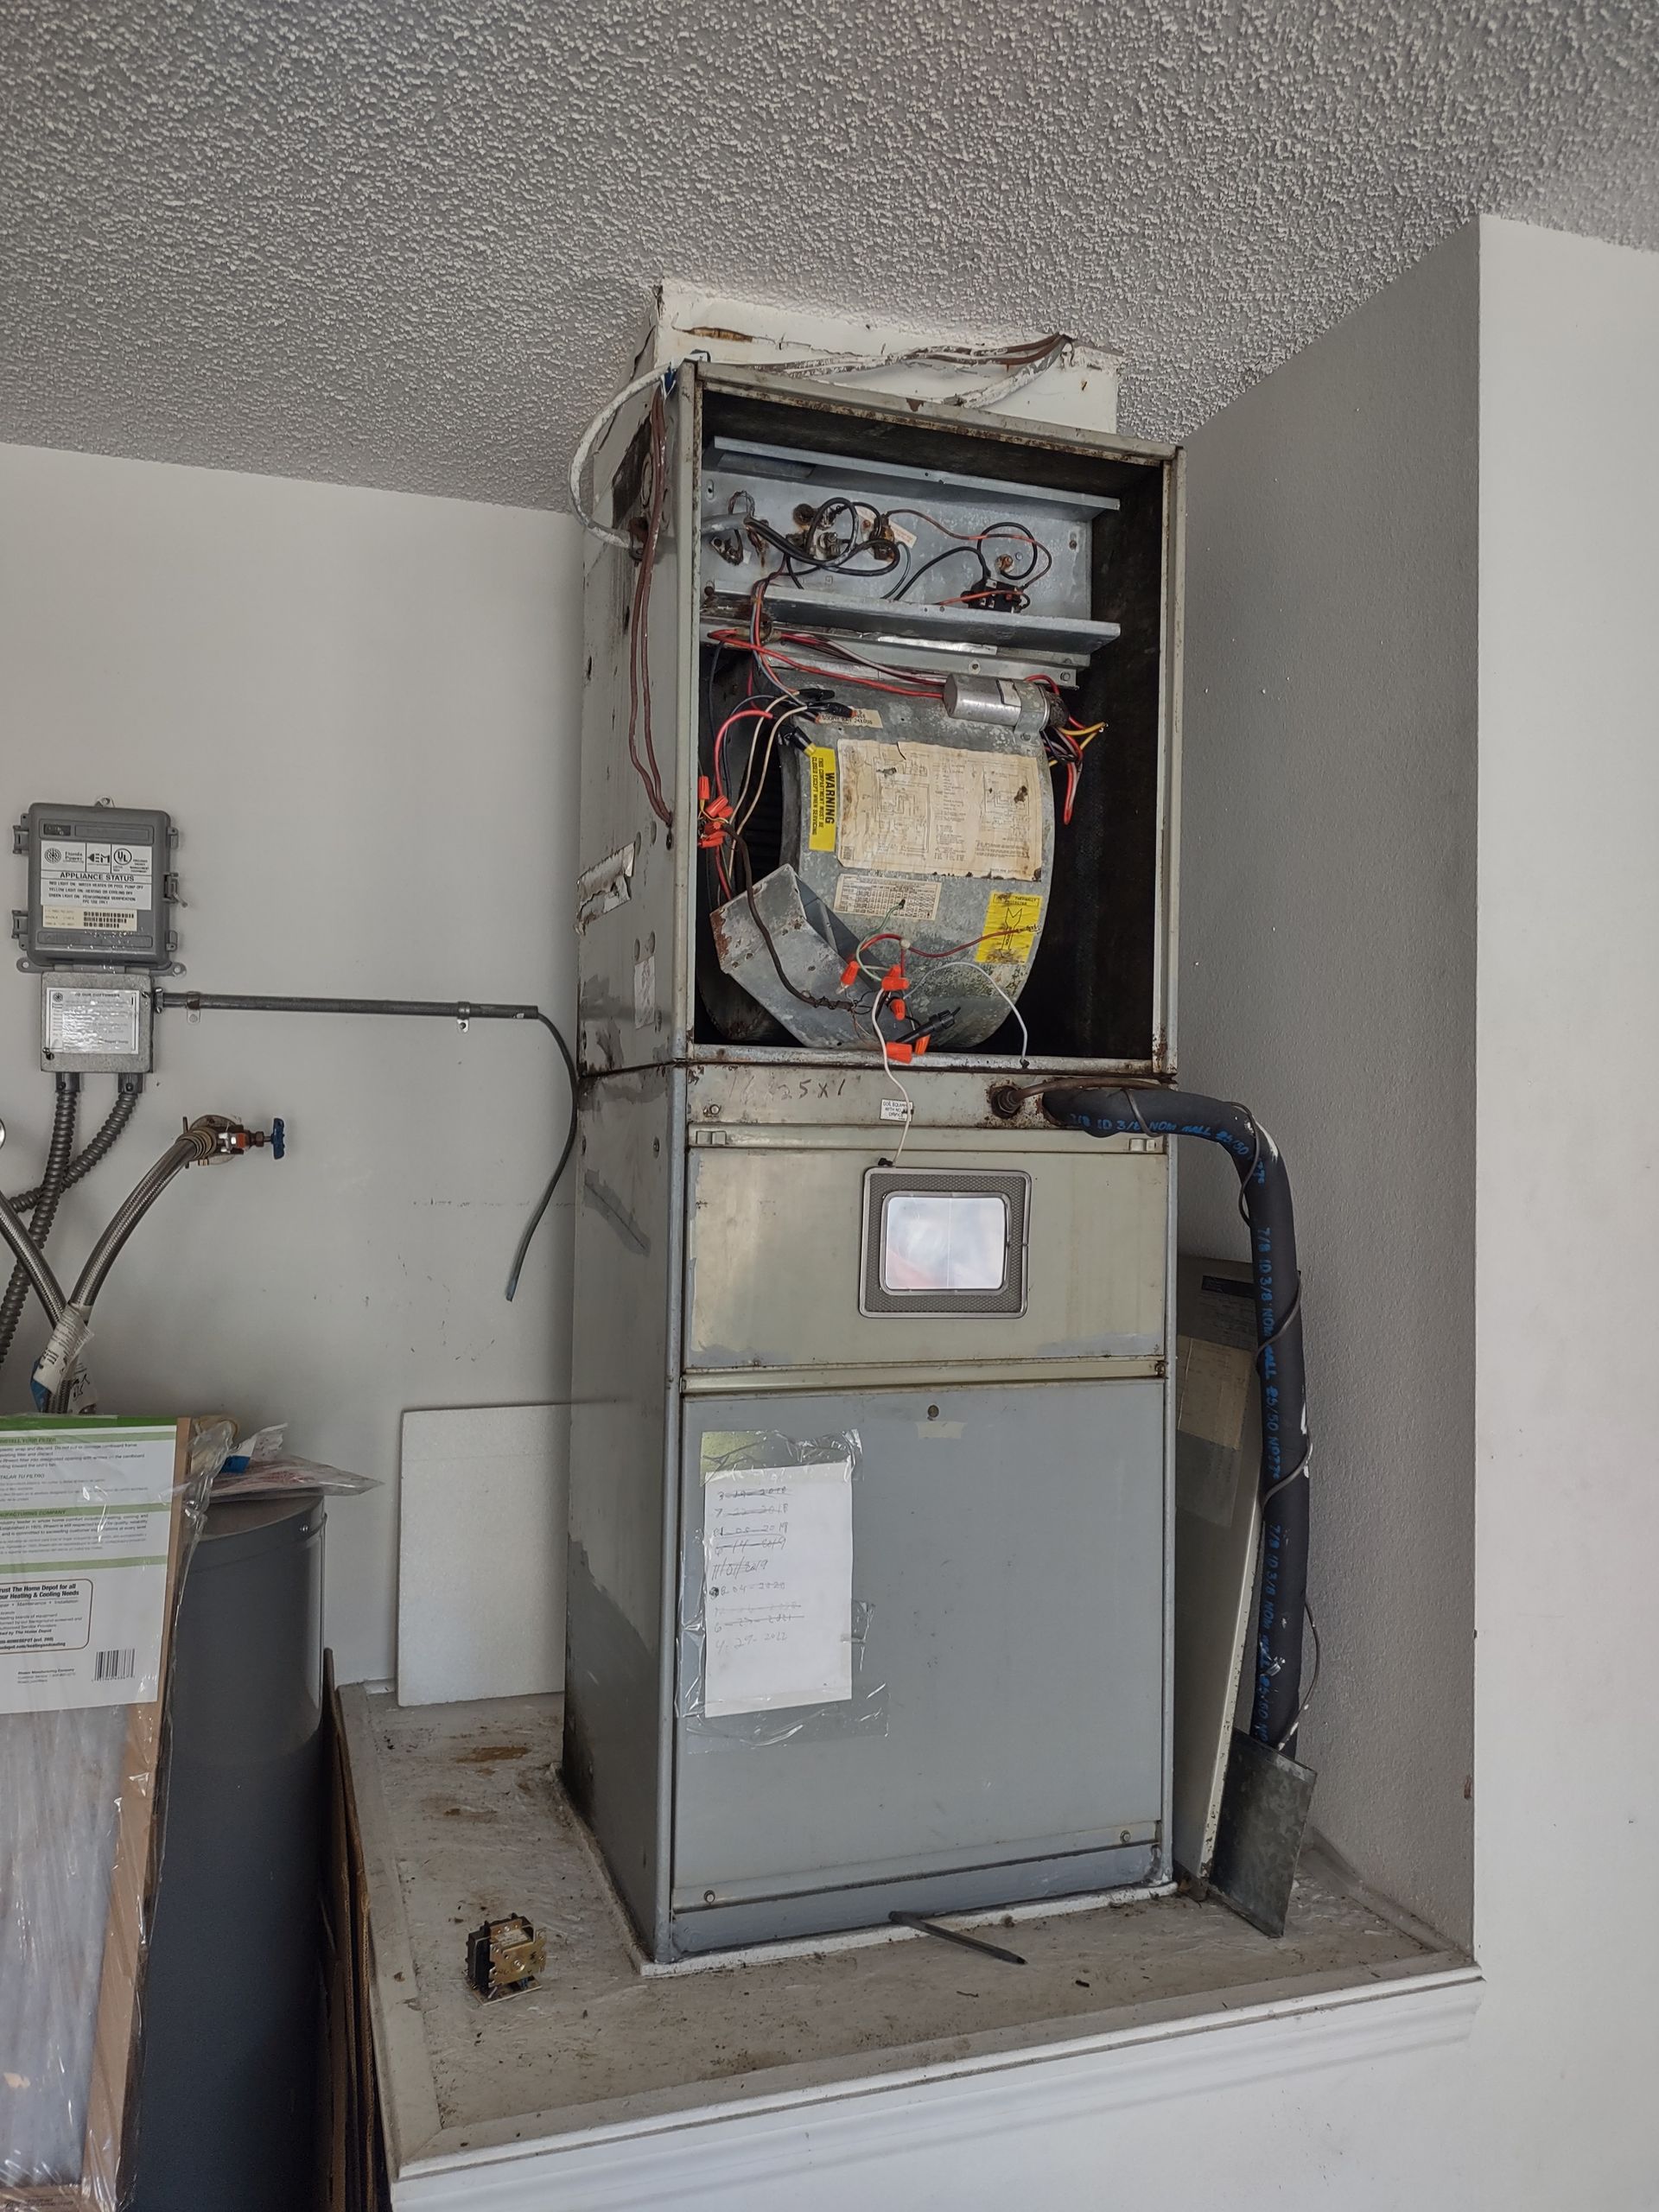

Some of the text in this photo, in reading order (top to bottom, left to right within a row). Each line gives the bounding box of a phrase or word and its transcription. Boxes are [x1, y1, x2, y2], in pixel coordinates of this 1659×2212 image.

[825, 772, 836, 824] WARNING
[118, 850, 129, 862] UL
[60, 871, 102, 880] APPLIANCE
[1097, 1119, 1113, 1130] ID
[1116, 1119, 1141, 1132] 3/8
[1148, 1121, 1177, 1131] NOM
[1257, 1227, 1272, 1253] 7/8
[1259, 1259, 1273, 1274] ID
[1260, 1276, 1273, 1301] 3/8
[1262, 1308, 1275, 1336] NOM
[1269, 1523, 1281, 1549] 7/8
[1266, 1572, 1277, 1596] 3/8
[1262, 1600, 1274, 1630] NOM
